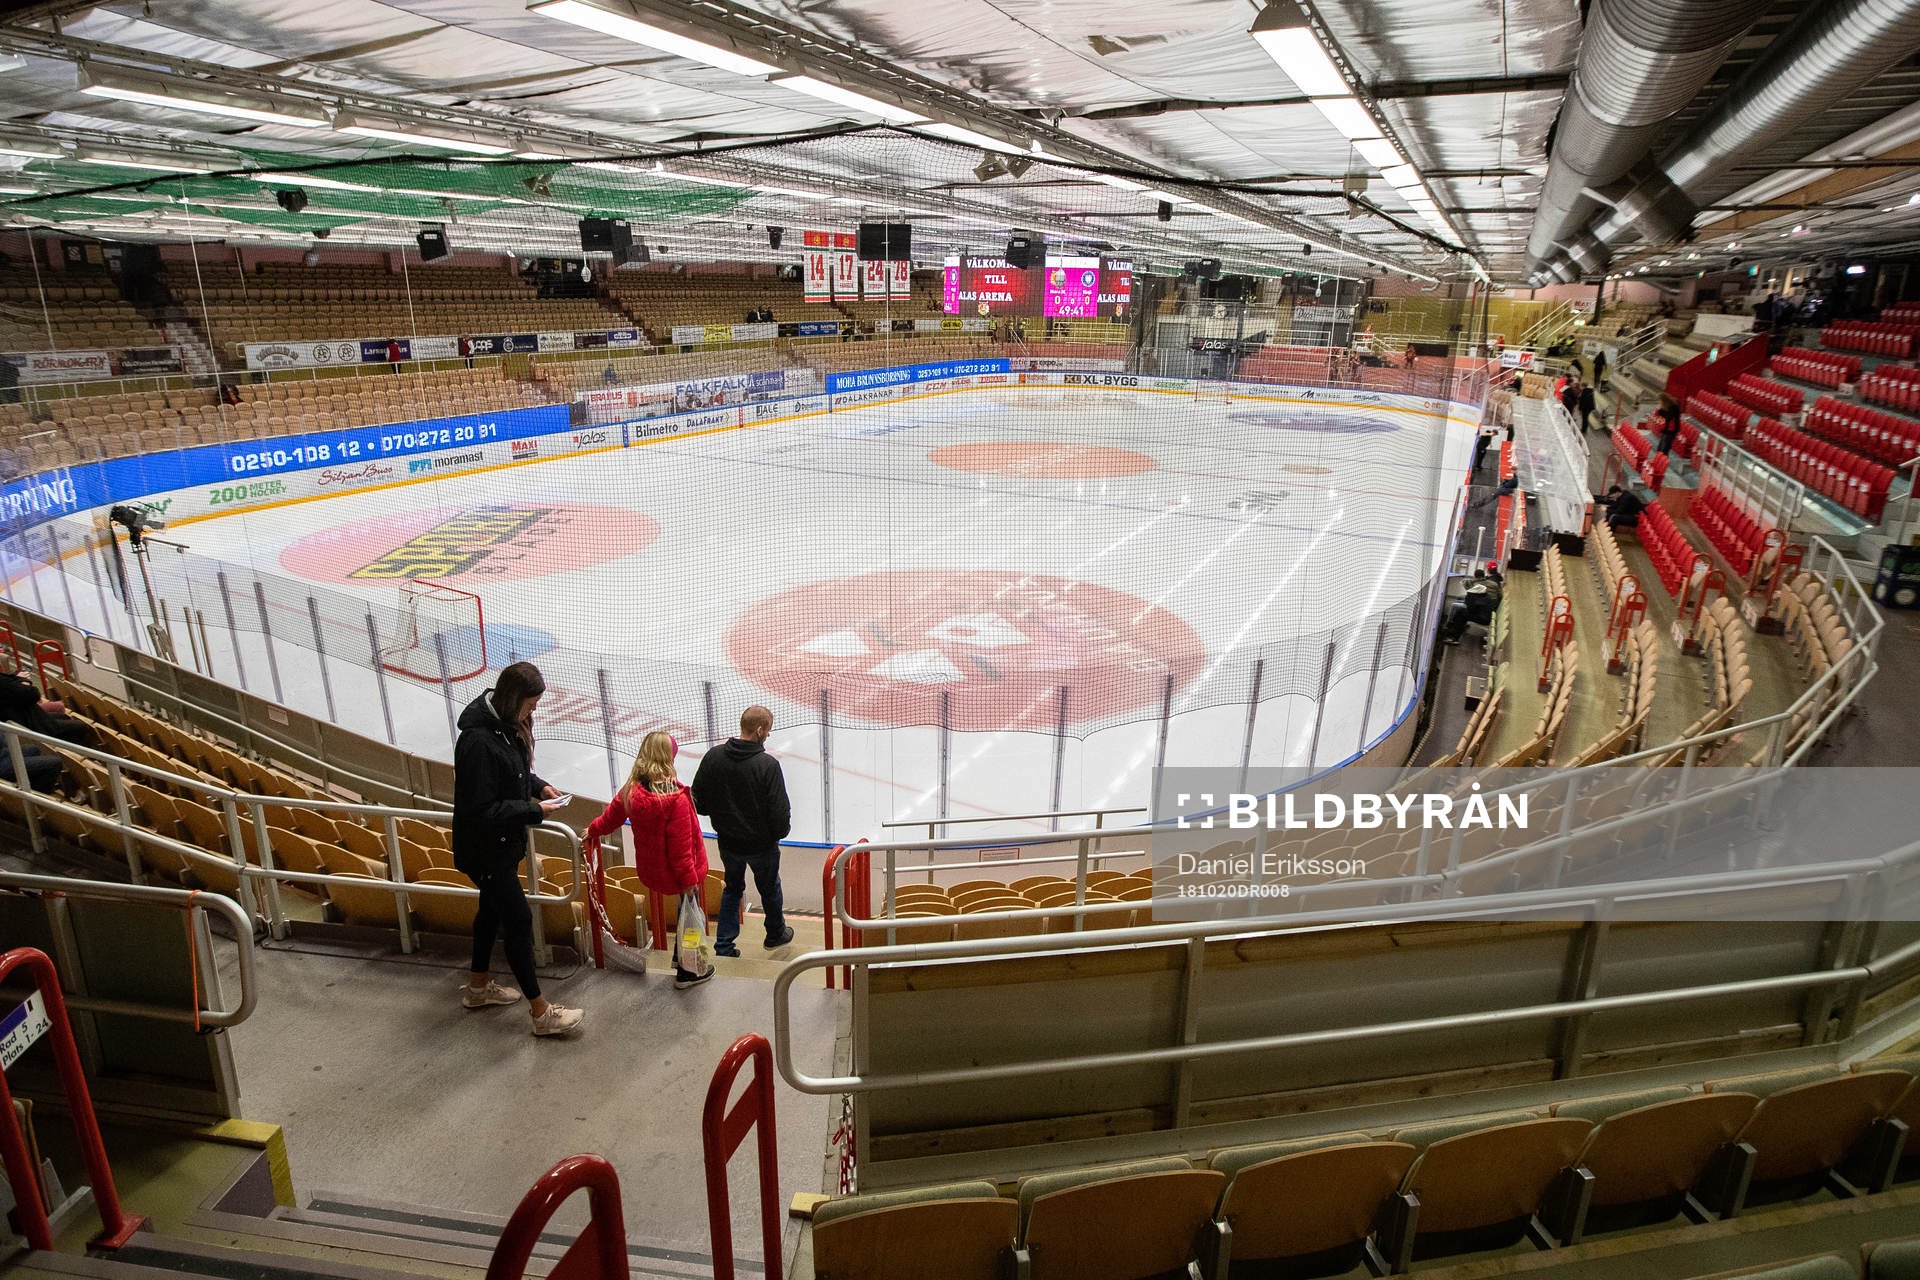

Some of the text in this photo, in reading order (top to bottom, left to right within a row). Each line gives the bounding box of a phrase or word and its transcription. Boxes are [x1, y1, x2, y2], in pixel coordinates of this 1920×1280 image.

[811, 254, 824, 280] 14
[840, 254, 853, 280] 17
[867, 260, 883, 281] 24
[985, 275, 1007, 284] TILL
[979, 292, 1013, 301] ARENA
[1055, 296, 1061, 305] 0
[1085, 296, 1090, 305] 0
[1059, 306, 1084, 315] 49:41
[1083, 375, 1138, 387] XL-BYGG
[635, 422, 679, 439] Bilmetro
[231, 444, 331, 473] 0250-108
[337, 440, 361, 457] 12
[455, 425, 474, 442] 20
[479, 422, 497, 438] 91
[511, 439, 538, 451] MAXI
[434, 450, 484, 468] moramast
[249, 479, 282, 491] METER
[249, 486, 287, 498] HOCKEY
[209, 484, 248, 506] 200
[0, 1022, 28, 1054] Rad 5
[2, 1044, 24, 1066] Plats
[36, 1018, 49, 1034] 24
